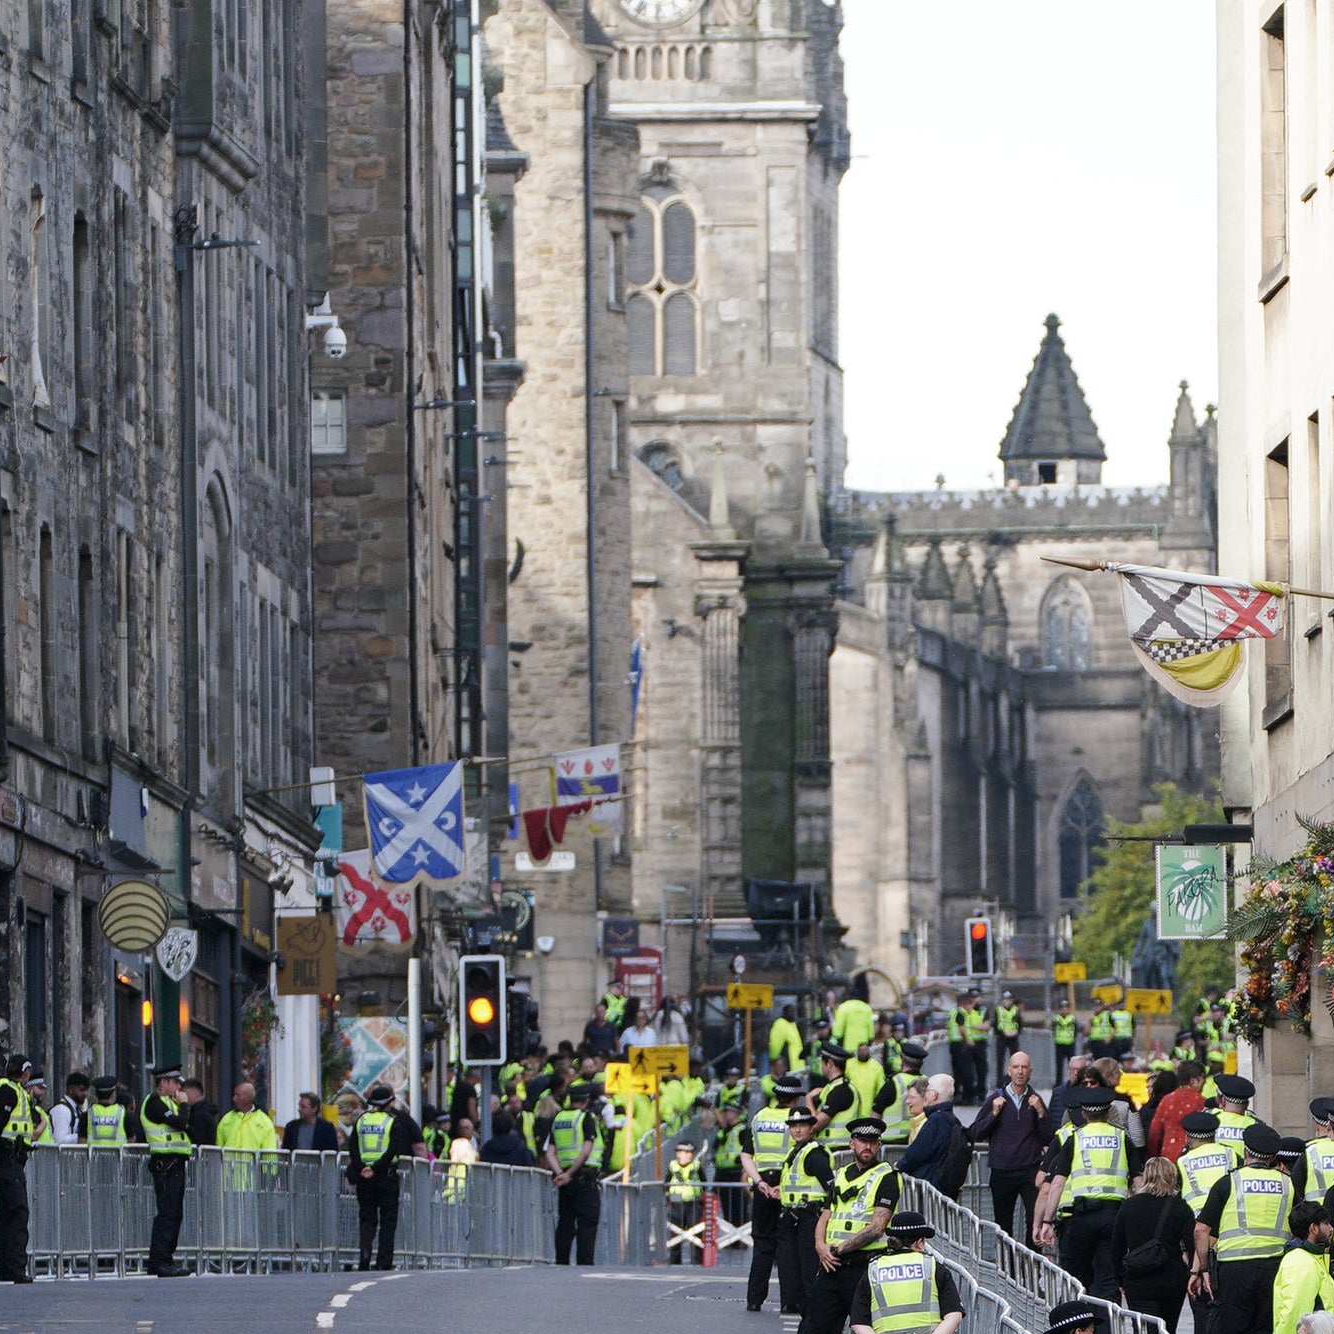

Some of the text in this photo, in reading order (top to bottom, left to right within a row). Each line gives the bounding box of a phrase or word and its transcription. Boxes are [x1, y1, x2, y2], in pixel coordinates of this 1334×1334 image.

[1182, 850, 1202, 858] THE
[1185, 924, 1203, 933] BAR
[756, 1122, 786, 1132] POLICE
[1082, 1137, 1118, 1149] POLICE
[1190, 1155, 1228, 1169] POLICE
[1244, 1180, 1283, 1193] POLICE
[880, 1265, 923, 1281] POLICE
